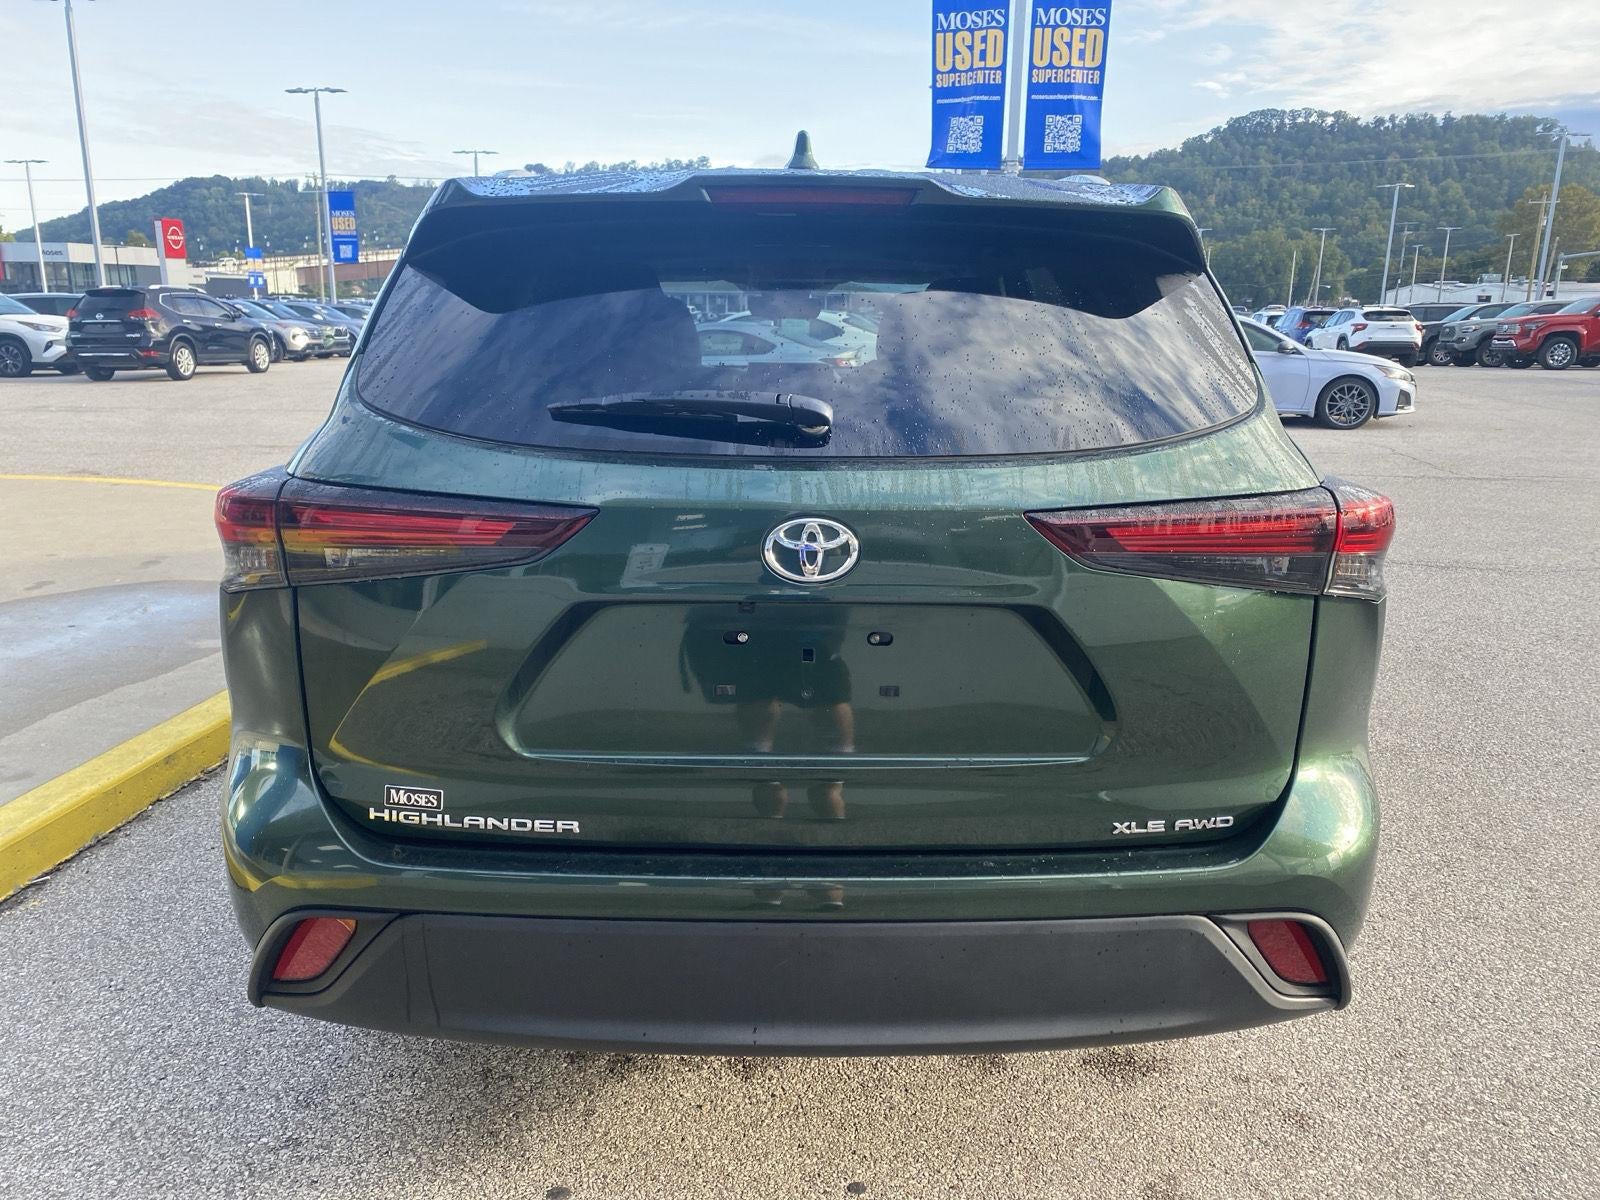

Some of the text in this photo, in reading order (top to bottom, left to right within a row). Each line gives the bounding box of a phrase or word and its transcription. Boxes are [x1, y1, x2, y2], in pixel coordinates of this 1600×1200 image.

[936, 9, 1006, 31] MOSES
[1035, 7, 1107, 27] MOSES
[935, 29, 1005, 72] USED
[1032, 27, 1105, 68] USED
[936, 70, 1002, 88] SUPERCENTER
[1032, 68, 1100, 84] SUPERCENTER
[332, 217, 357, 230] USED
[368, 808, 580, 833] HIGHLANDER
[1112, 816, 1234, 834] XLE AWD
